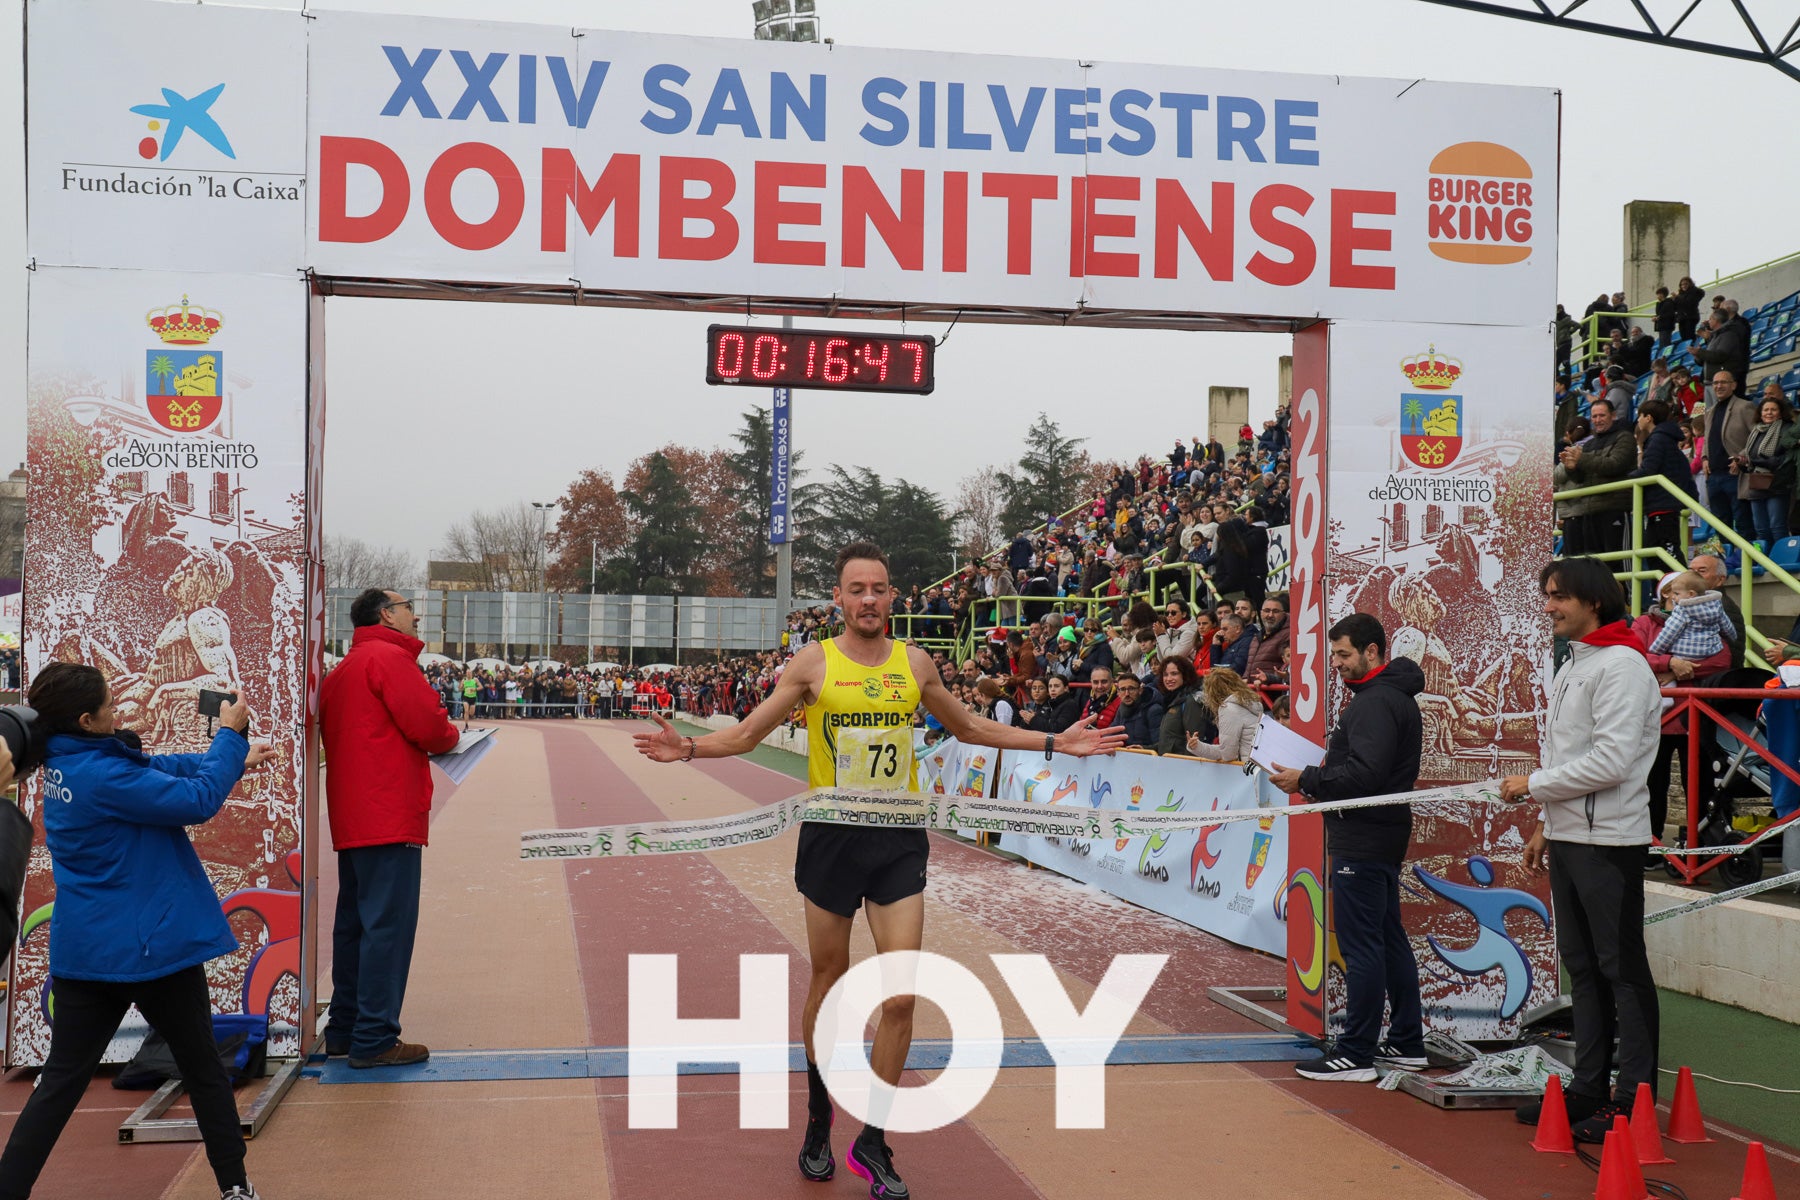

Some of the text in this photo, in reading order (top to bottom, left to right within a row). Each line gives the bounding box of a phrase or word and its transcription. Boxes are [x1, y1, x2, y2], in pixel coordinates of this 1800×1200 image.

[381, 46, 1319, 166] XXIV SAN SILVESTRE
[62, 168, 192, 197] Fundación
[1428, 177, 1533, 207] BURGER
[319, 135, 1397, 290] DOMBENITENSE
[1428, 203, 1533, 243] KING
[717, 333, 923, 383] 00:16:47
[128, 438, 256, 457] Ayuntamiento
[186, 453, 259, 469] BENITO
[1385, 474, 1489, 490] Ayuntamiento
[1433, 488, 1492, 503] BENITO
[307, 354, 323, 717] 2023
[1293, 388, 1322, 723] 2023
[868, 743, 898, 778] 73
[839, 808, 926, 826] EXTREMADURA
[1007, 820, 1085, 837] EXTREMADURA
[710, 823, 779, 847] EXTREMADURA
